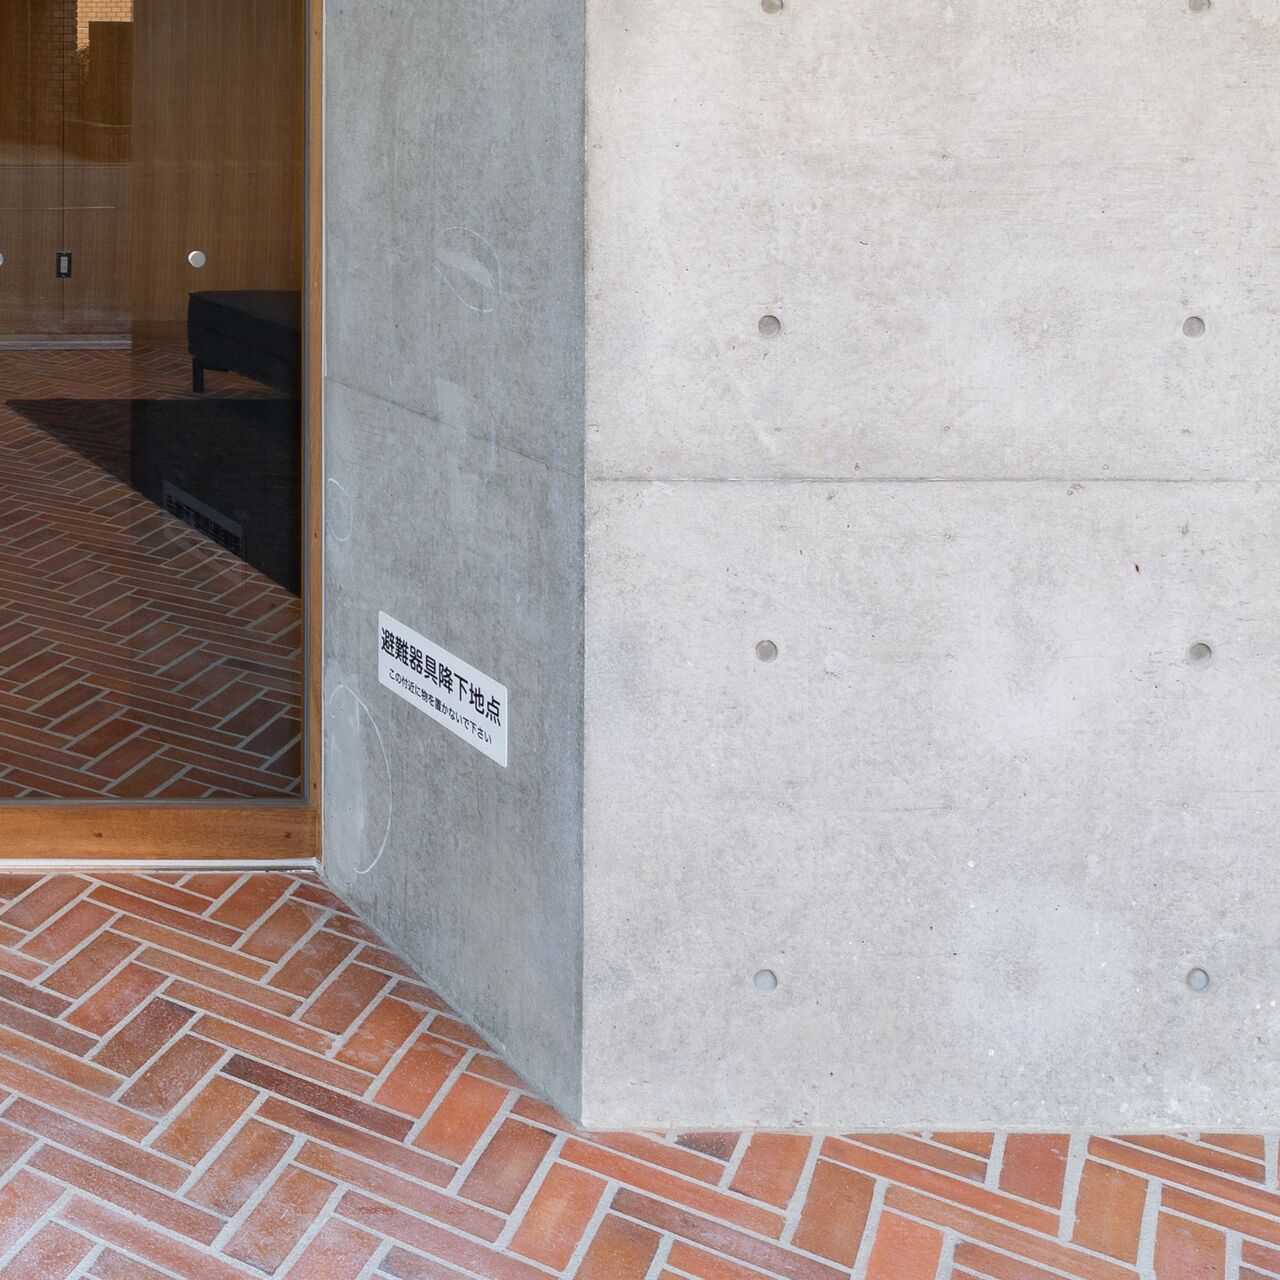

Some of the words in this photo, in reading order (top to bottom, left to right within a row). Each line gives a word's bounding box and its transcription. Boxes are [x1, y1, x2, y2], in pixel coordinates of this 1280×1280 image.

[381, 627, 502, 727] 避難器具降下地点
[389, 668, 492, 744] この付近に物を置かないで下さい
